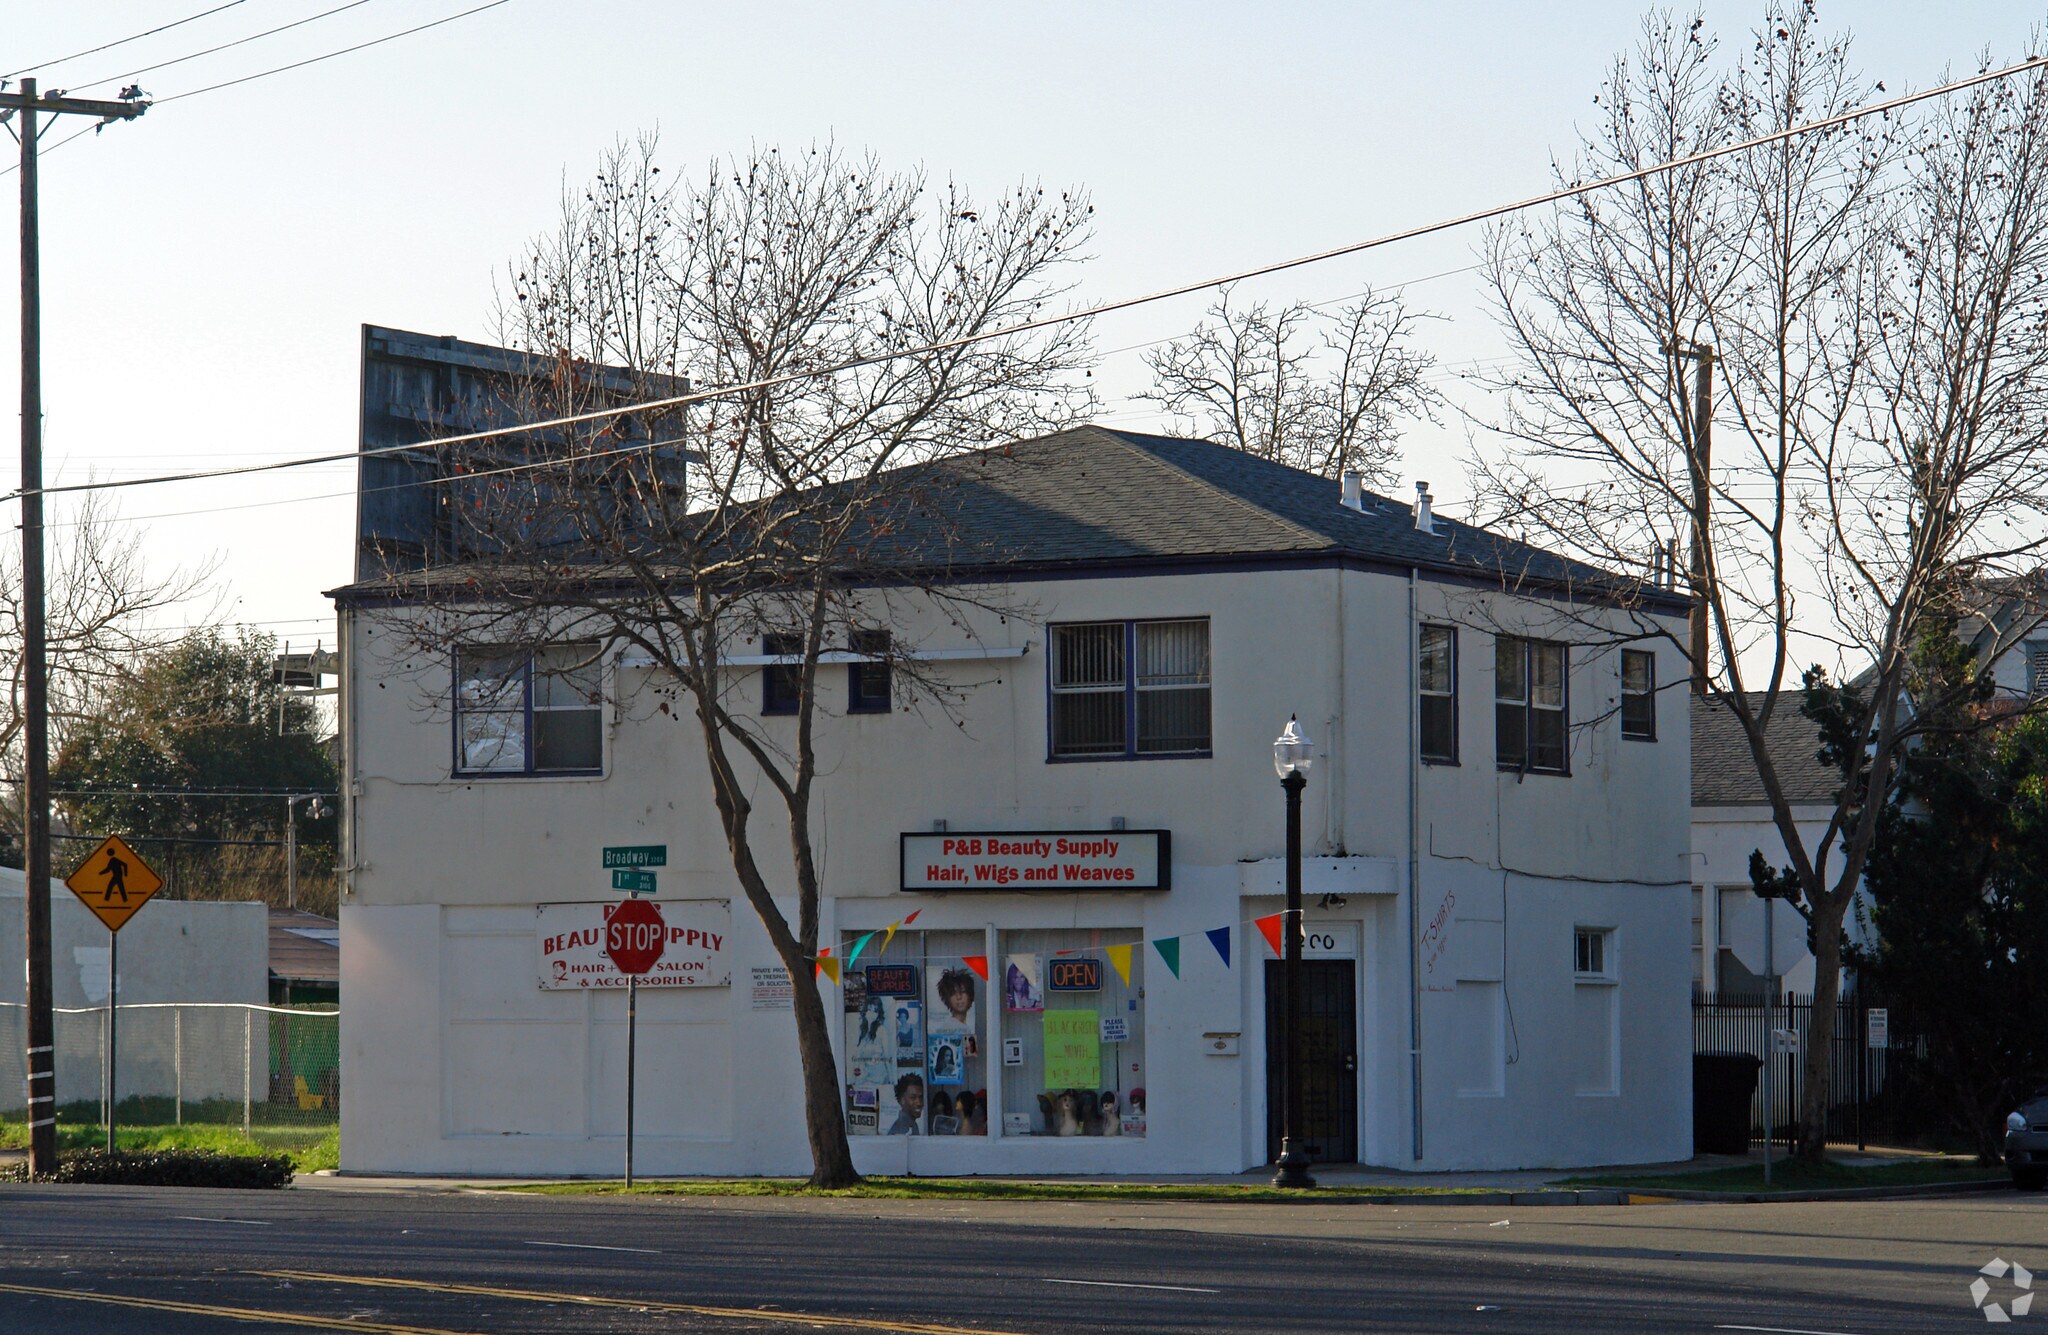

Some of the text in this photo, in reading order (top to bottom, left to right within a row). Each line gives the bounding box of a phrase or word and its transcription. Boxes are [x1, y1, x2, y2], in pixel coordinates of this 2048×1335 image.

[943, 838, 1119, 859] P&B Beauty Supply
[606, 850, 649, 867] Broadway
[927, 865, 1135, 884] Hair, Wigs and Weaves
[1420, 889, 1456, 950] T-SHIRTS
[610, 922, 661, 951] STOP
[571, 963, 606, 973] HAIR
[656, 962, 705, 972] SALON
[870, 969, 911, 980] BEAUTY
[1054, 964, 1097, 987] OPEN
[580, 978, 590, 987] &
[870, 980, 912, 991] SUPPLIES
[849, 1114, 875, 1126] CLOSED
